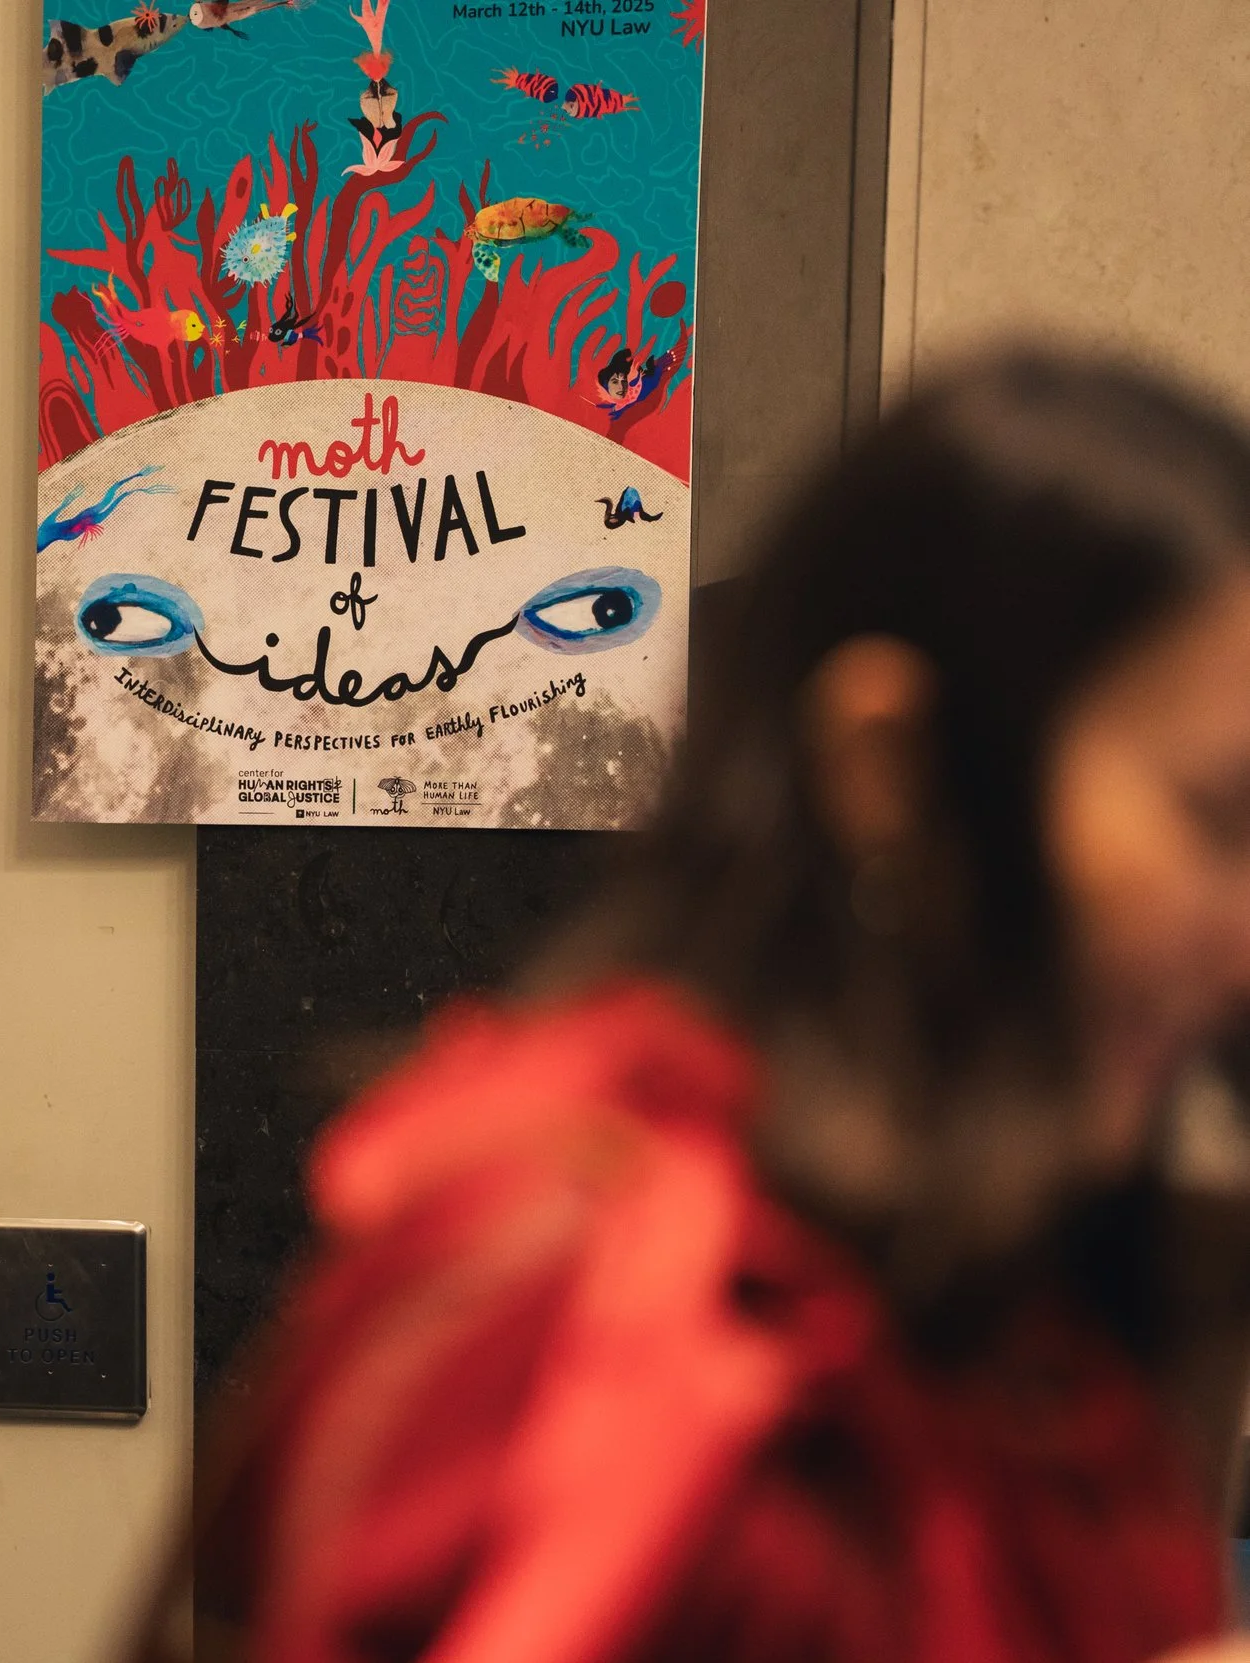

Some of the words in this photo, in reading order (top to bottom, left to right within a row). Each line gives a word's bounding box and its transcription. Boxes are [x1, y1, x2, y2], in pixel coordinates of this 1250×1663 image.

[453, 3, 502, 19] March
[508, 2, 545, 17] 12th
[564, 0, 606, 16] 14th,
[612, 0, 655, 13] 2025
[561, 19, 604, 36] NYU
[611, 18, 651, 35] Law
[258, 393, 426, 480] moth
[187, 470, 527, 567] FESTIVAL
[330, 572, 379, 631] of
[193, 613, 521, 707] ideas
[274, 730, 380, 751] PERSPECTIVES
[391, 732, 416, 749] FOR
[238, 769, 268, 778] center
[270, 768, 284, 778] for
[238, 779, 285, 792] HUMAN
[286, 779, 333, 792] RIGHTS
[423, 781, 448, 790] MORE
[452, 781, 477, 790] THAN
[238, 792, 287, 803] GLOBAL
[287, 791, 340, 808] JUSTICE
[423, 791, 454, 800] HUMAN
[458, 791, 479, 800] LIFE
[370, 797, 409, 816] moth
[433, 807, 452, 816] NYU
[454, 807, 471, 816] Law
[24, 1328, 77, 1343] PUSH
[7, 1349, 32, 1364] TO
[41, 1350, 95, 1366] OPEN
